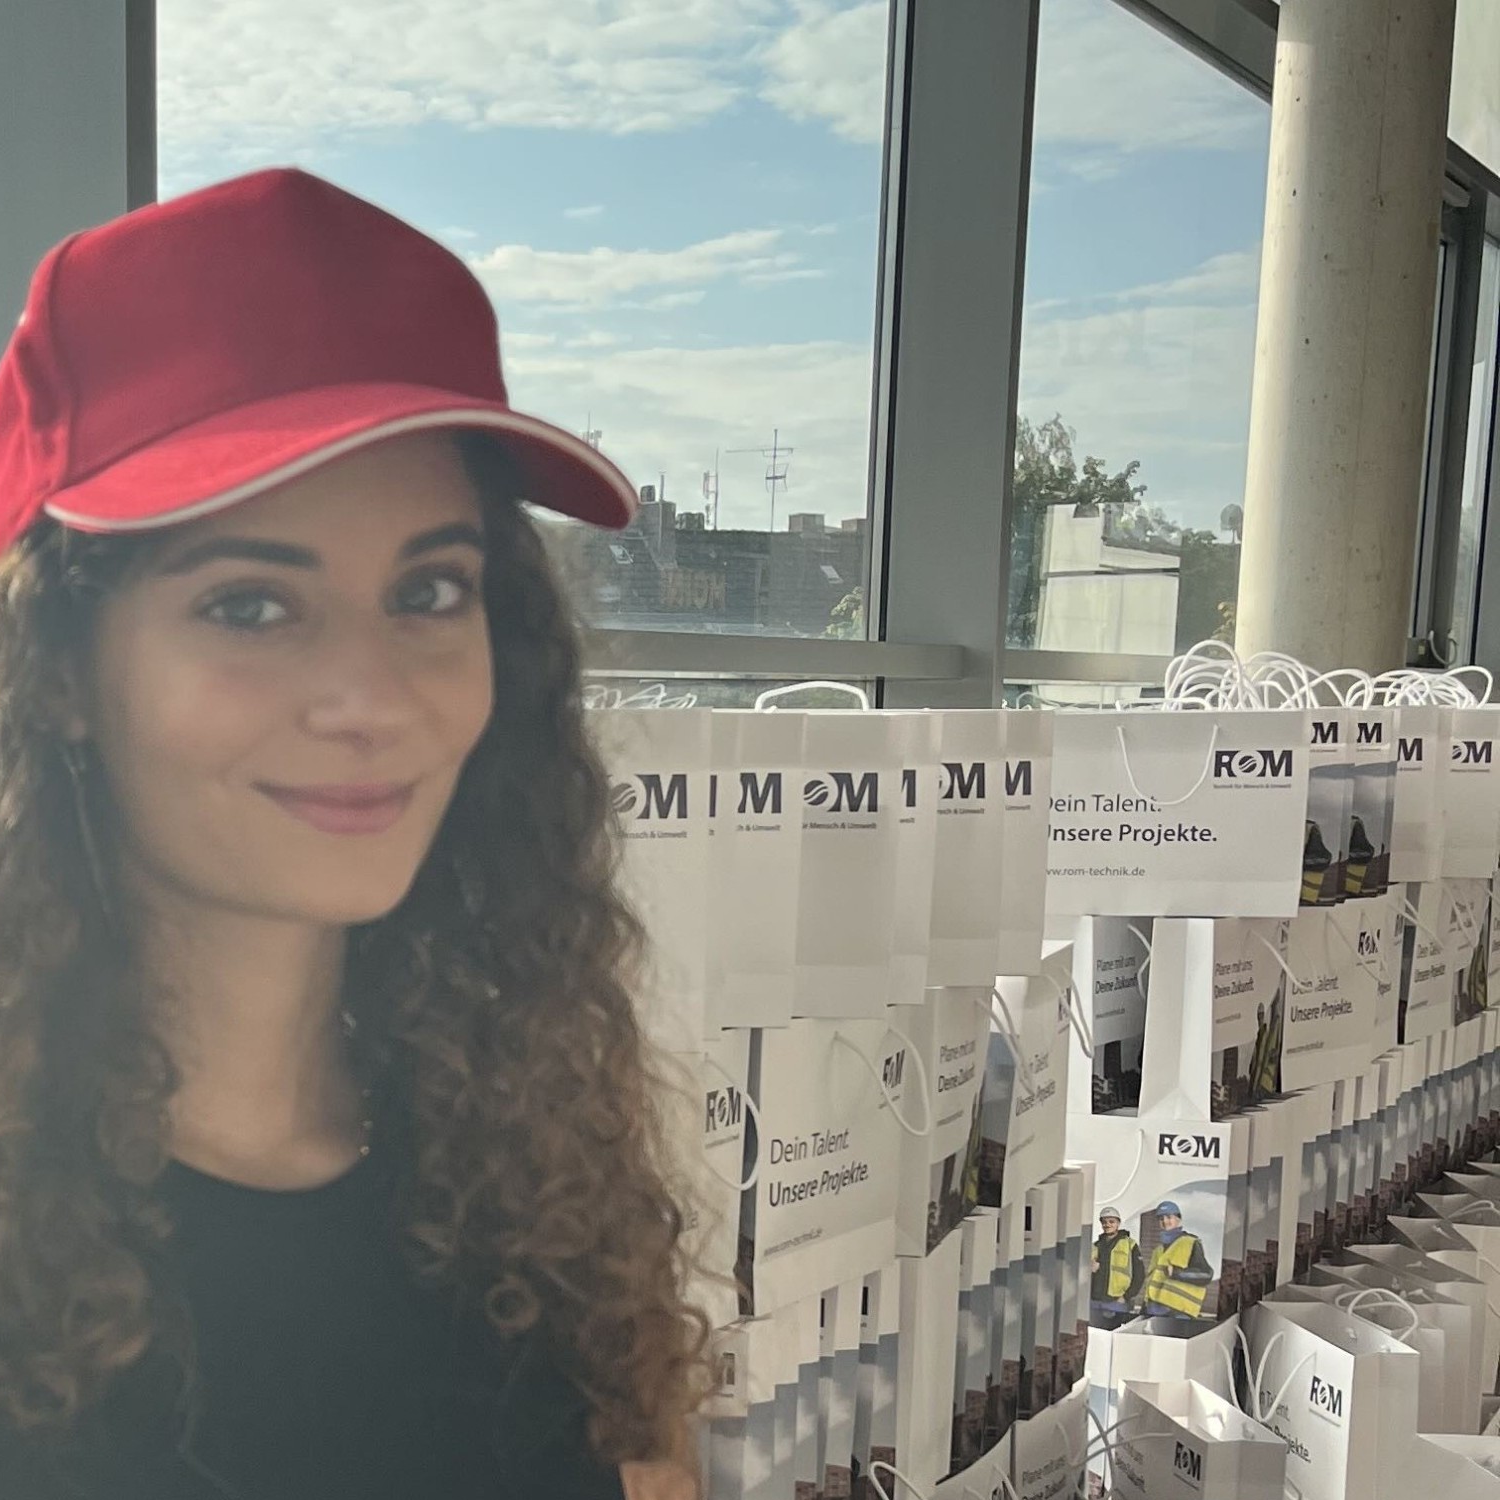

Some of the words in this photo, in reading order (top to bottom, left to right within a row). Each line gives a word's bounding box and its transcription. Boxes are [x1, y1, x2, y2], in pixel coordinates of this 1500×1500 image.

[1214, 750, 1292, 777] ROM
[607, 774, 688, 819] OM
[803, 772, 879, 813] OM
[1048, 824, 1112, 842] nsere
[1119, 823, 1218, 847] Projekte.
[770, 1136, 808, 1165] Dein
[1158, 1133, 1220, 1158] ROM
[768, 1176, 819, 1207] Unsere
[1310, 1375, 1342, 1418] ROM
